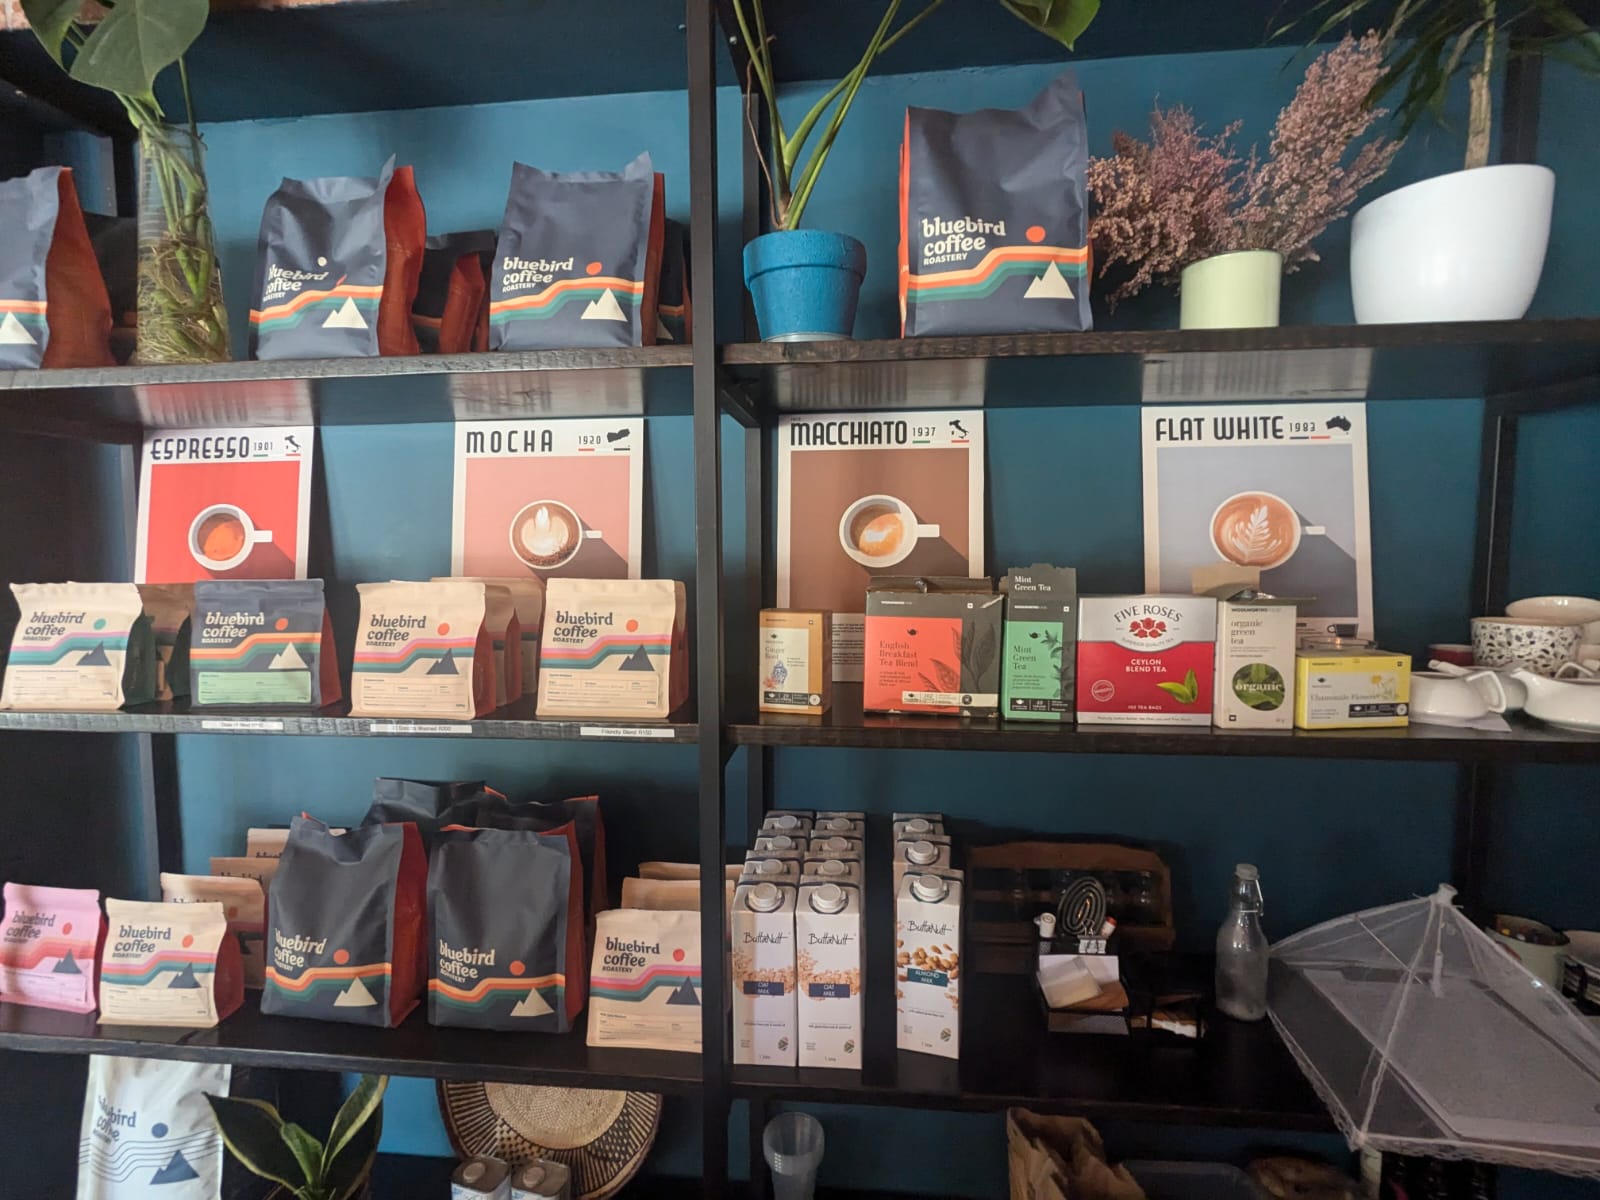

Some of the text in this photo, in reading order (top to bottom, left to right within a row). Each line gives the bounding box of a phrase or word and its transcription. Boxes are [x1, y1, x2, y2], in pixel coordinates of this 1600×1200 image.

[922, 216, 1006, 238] bluebird
[924, 234, 986, 257] coffee
[503, 256, 573, 272] bluebird
[923, 252, 968, 266] ROASTERY
[502, 270, 553, 286] coffee
[502, 282, 536, 293] ROASTERY
[790, 420, 936, 446] MACCHIATO 1937
[1155, 415, 1316, 441] FLAT WHITE 1983
[150, 435, 273, 460] ESPRESSO 1901
[466, 429, 602, 454] MOCHA 1920
[1014, 575, 1032, 583] Mint
[1014, 583, 1052, 591] Green Tea
[30, 611, 87, 624] bluebird
[205, 612, 265, 625] bluebird
[556, 610, 614, 626] bluebird
[1113, 604, 1184, 623] FIVE ROSES
[370, 614, 427, 628] bluebird
[25, 624, 66, 636] coffee
[202, 625, 248, 638] coffee
[367, 628, 410, 641] coffee
[553, 625, 598, 638] coffee
[1231, 629, 1256, 637] green
[880, 640, 910, 650] English
[1013, 645, 1032, 653] Mint
[879, 650, 917, 659] Breakfast
[1012, 653, 1037, 662] Green
[880, 659, 918, 667] Tea Blend
[1012, 662, 1027, 670] Tea
[1235, 682, 1282, 692] organic
[12, 910, 57, 927] bluebird
[6, 925, 41, 939] coffee
[119, 924, 171, 940] bluebird
[114, 939, 156, 952] coffee
[606, 936, 661, 955] bluebird
[440, 939, 496, 966] bluebird
[603, 952, 646, 967] coffee
[440, 958, 479, 979] coffee
[602, 965, 633, 973] ROASTERY
